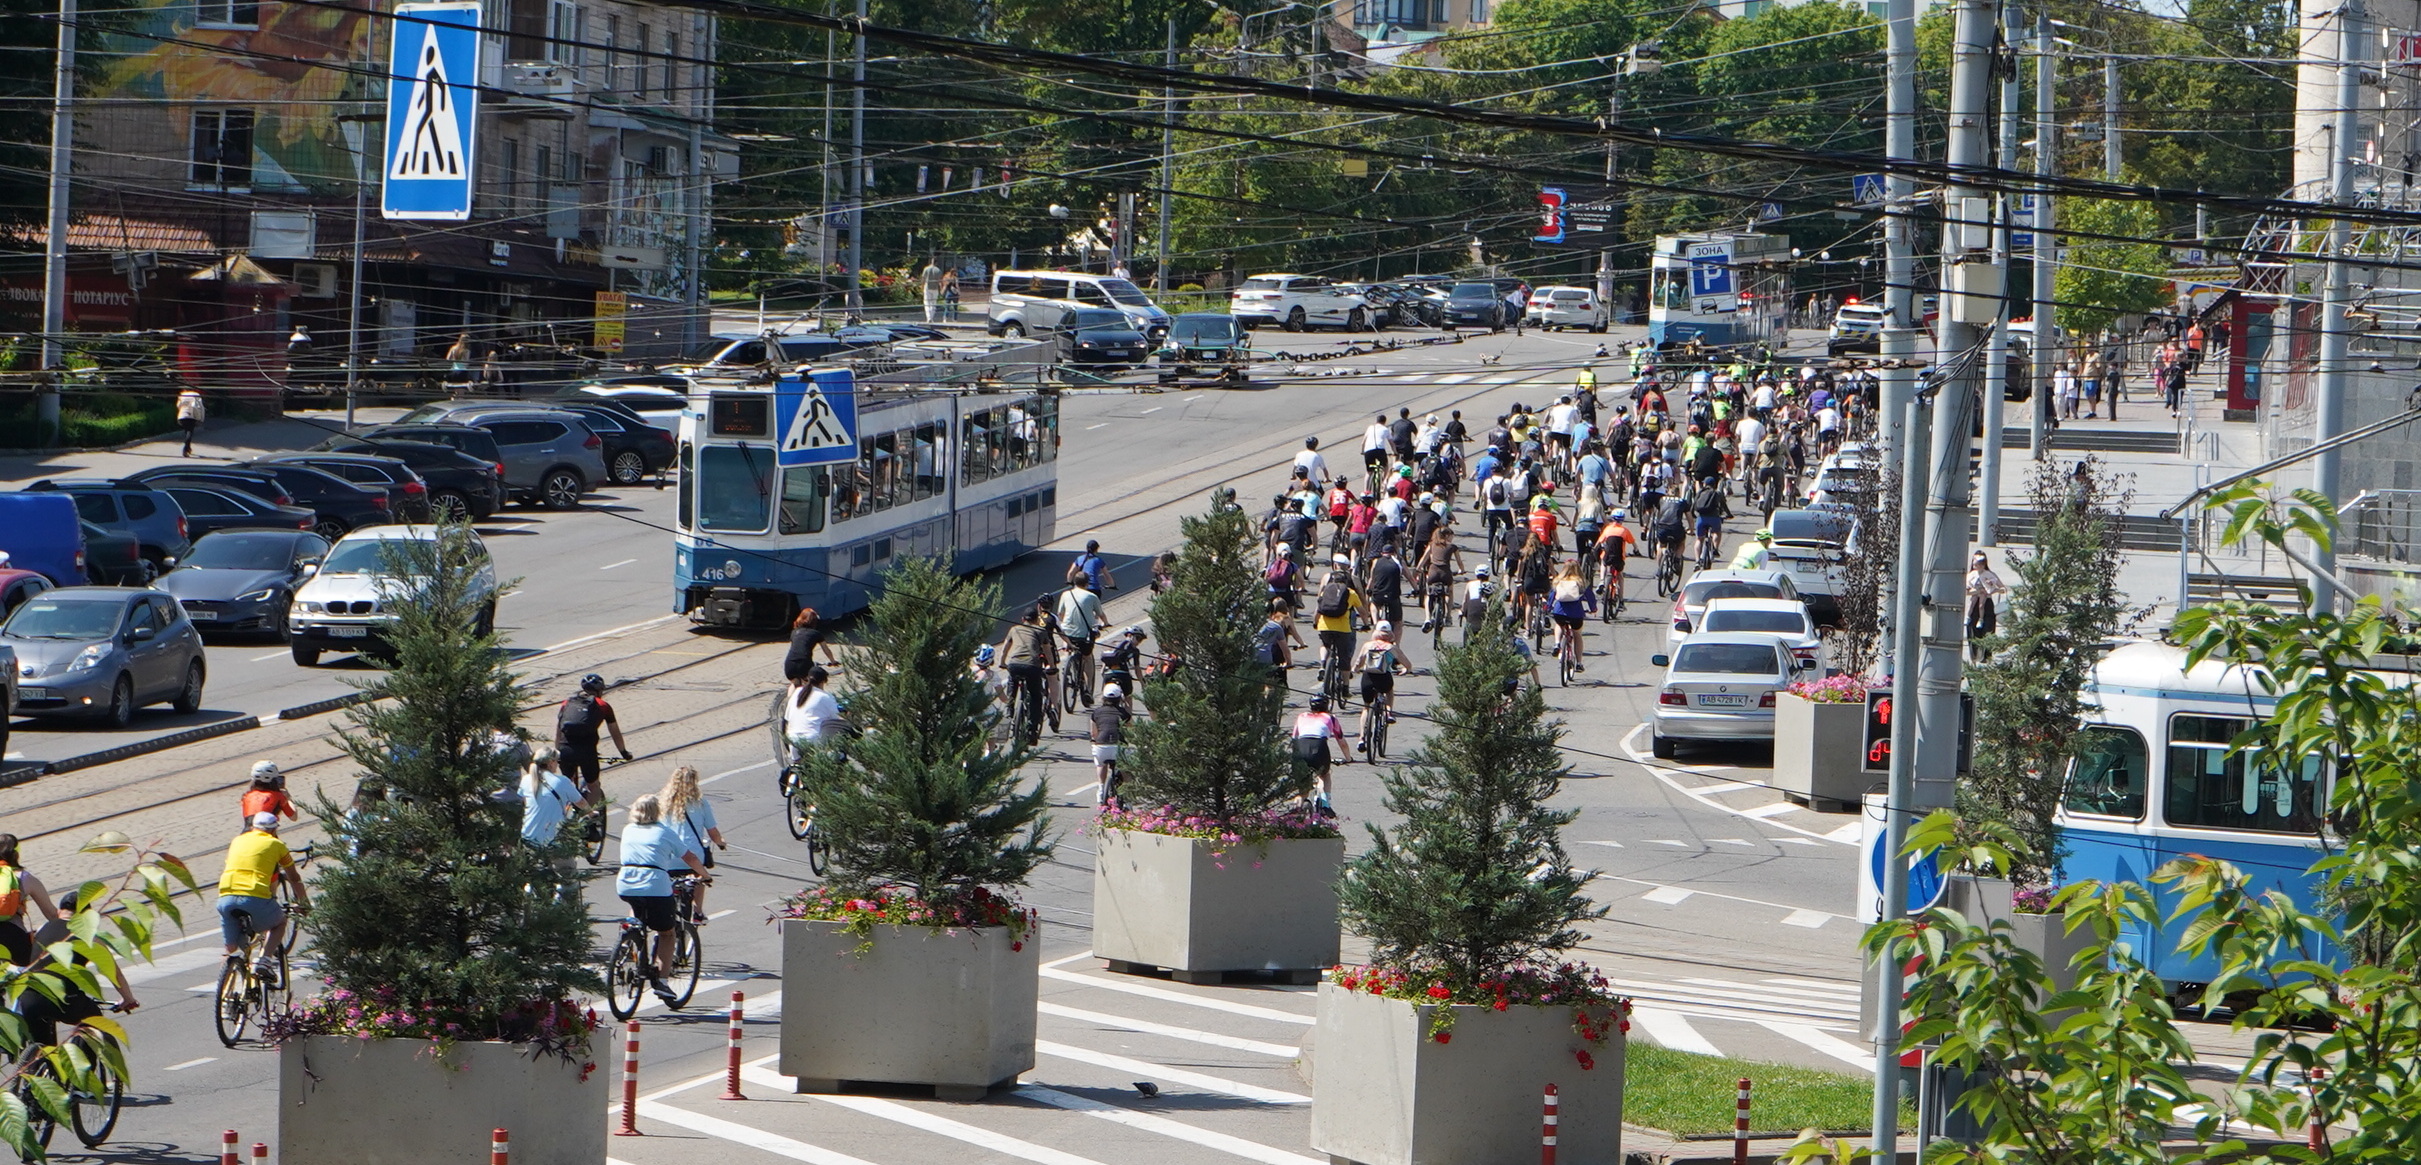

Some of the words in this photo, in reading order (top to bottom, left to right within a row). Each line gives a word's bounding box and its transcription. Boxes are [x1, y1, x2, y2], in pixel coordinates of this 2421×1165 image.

[1695, 246, 1724, 255] ЗОНА
[74, 291, 128, 305] НОТАРІУС
[702, 568, 724, 580] 416
